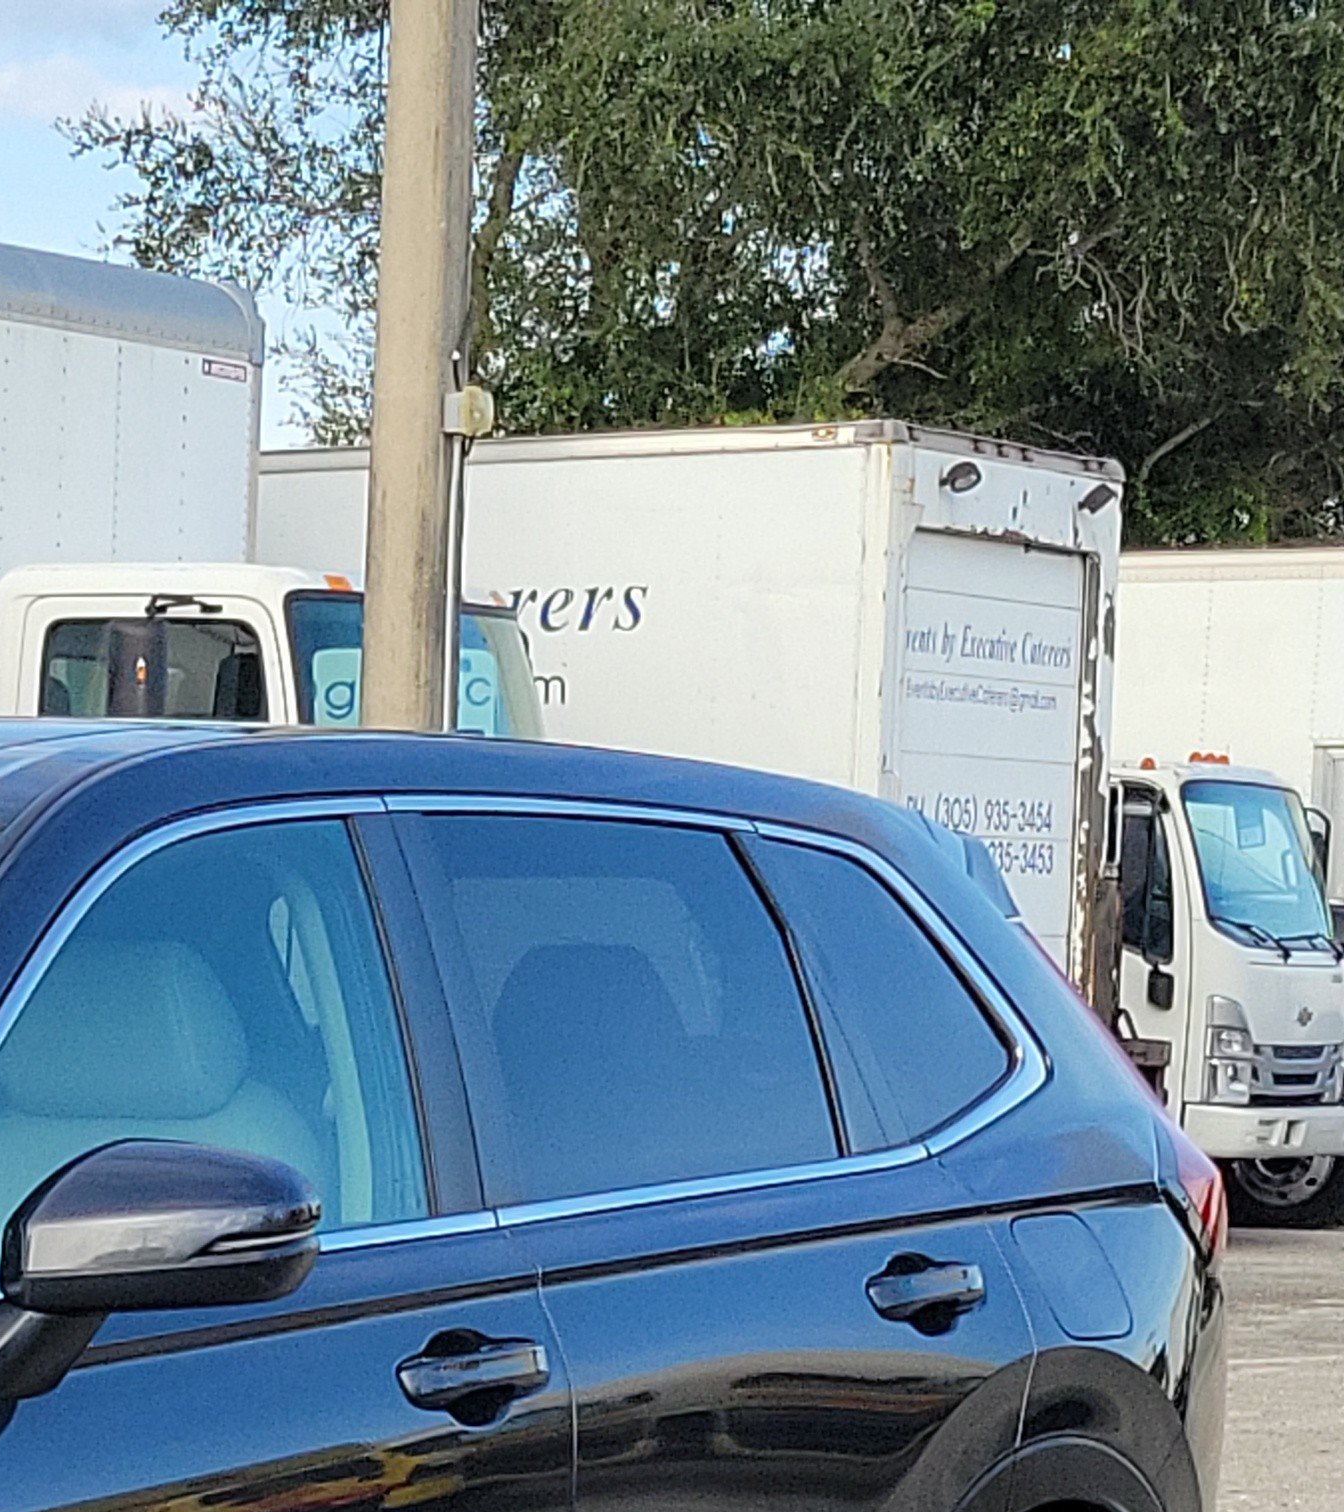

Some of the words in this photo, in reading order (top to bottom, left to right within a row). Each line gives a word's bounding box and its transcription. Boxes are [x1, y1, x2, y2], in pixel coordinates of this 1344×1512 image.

[940, 621, 956, 663] by
[960, 625, 1018, 663] Executive
[1021, 631, 1071, 669] Caterers
[934, 792, 978, 832] (305)
[984, 798, 1053, 833] 935-3454
